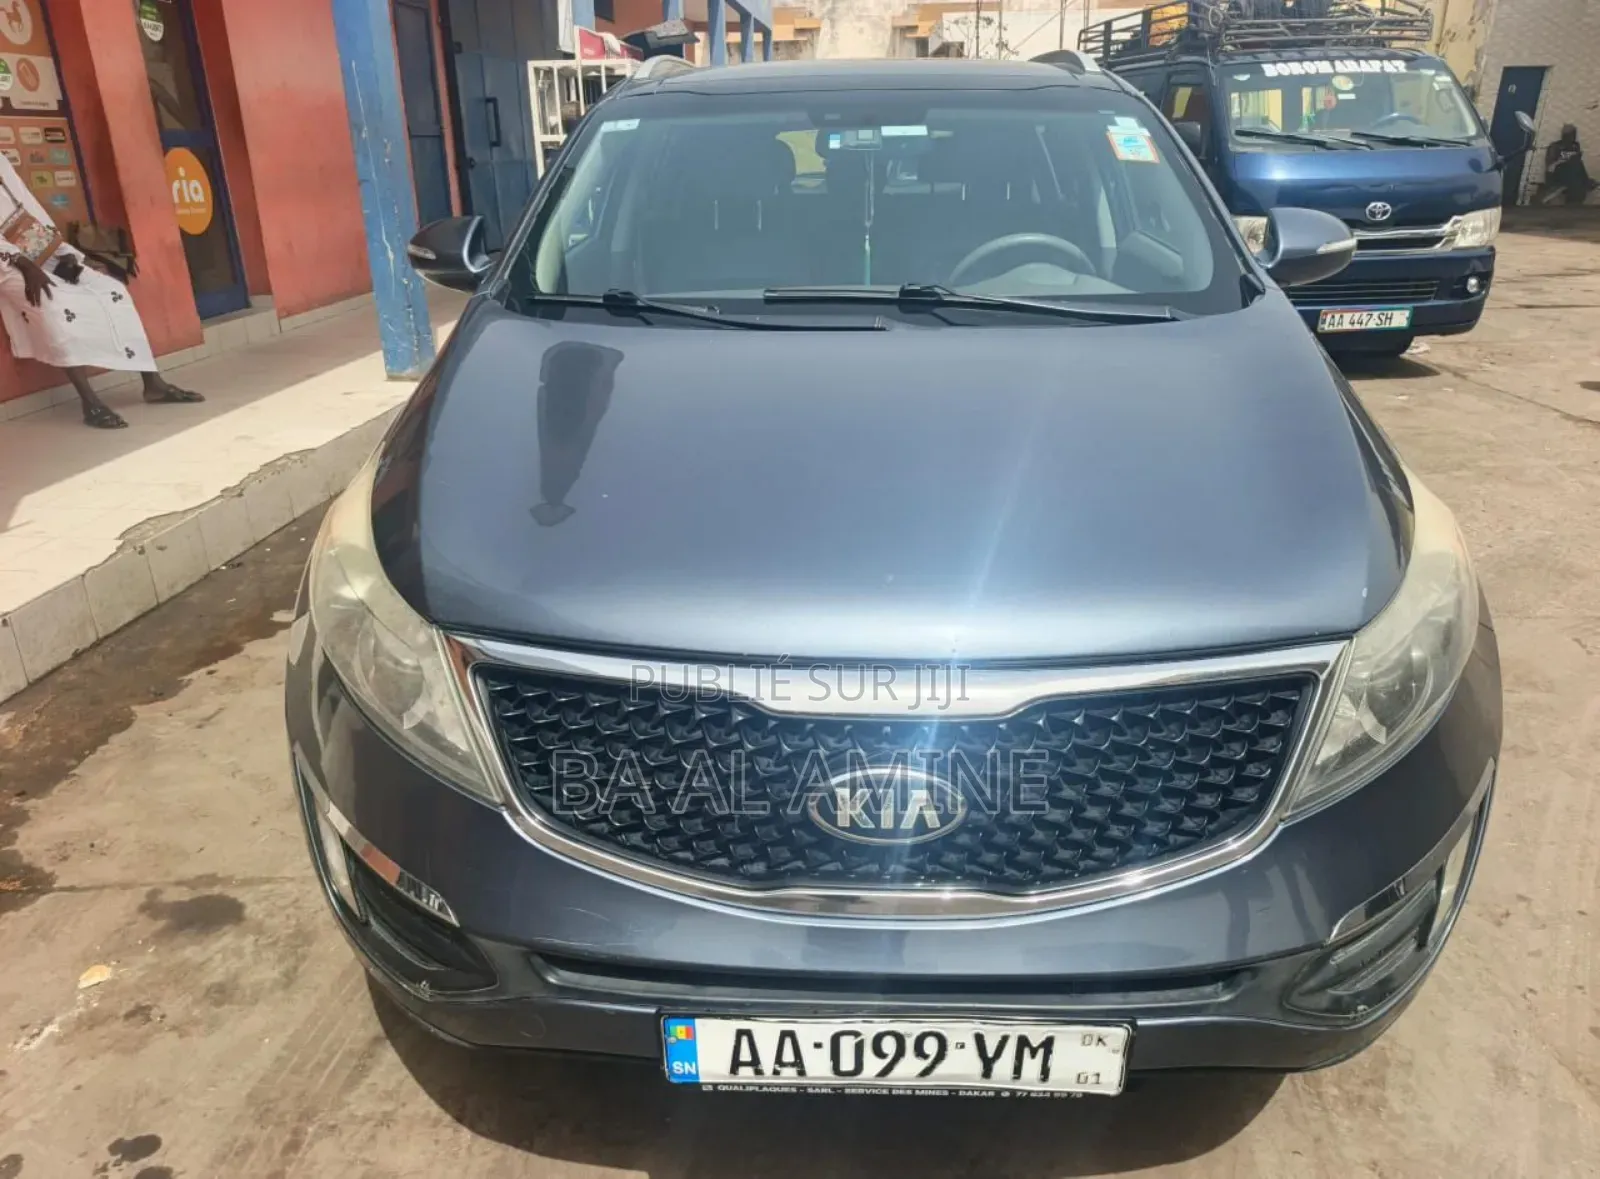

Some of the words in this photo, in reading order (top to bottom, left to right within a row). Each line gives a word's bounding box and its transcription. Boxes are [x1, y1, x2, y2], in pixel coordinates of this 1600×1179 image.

[172, 166, 205, 204] ria
[834, 787, 941, 829] KIA
[672, 1062, 697, 1075] SN
[717, 1084, 797, 1094] QUALIPLAQUES
[807, 1086, 835, 1095] SARL
[844, 1087, 890, 1095] SERVICE
[914, 1089, 949, 1097] MINES
[958, 1090, 996, 1098] DAKAR
